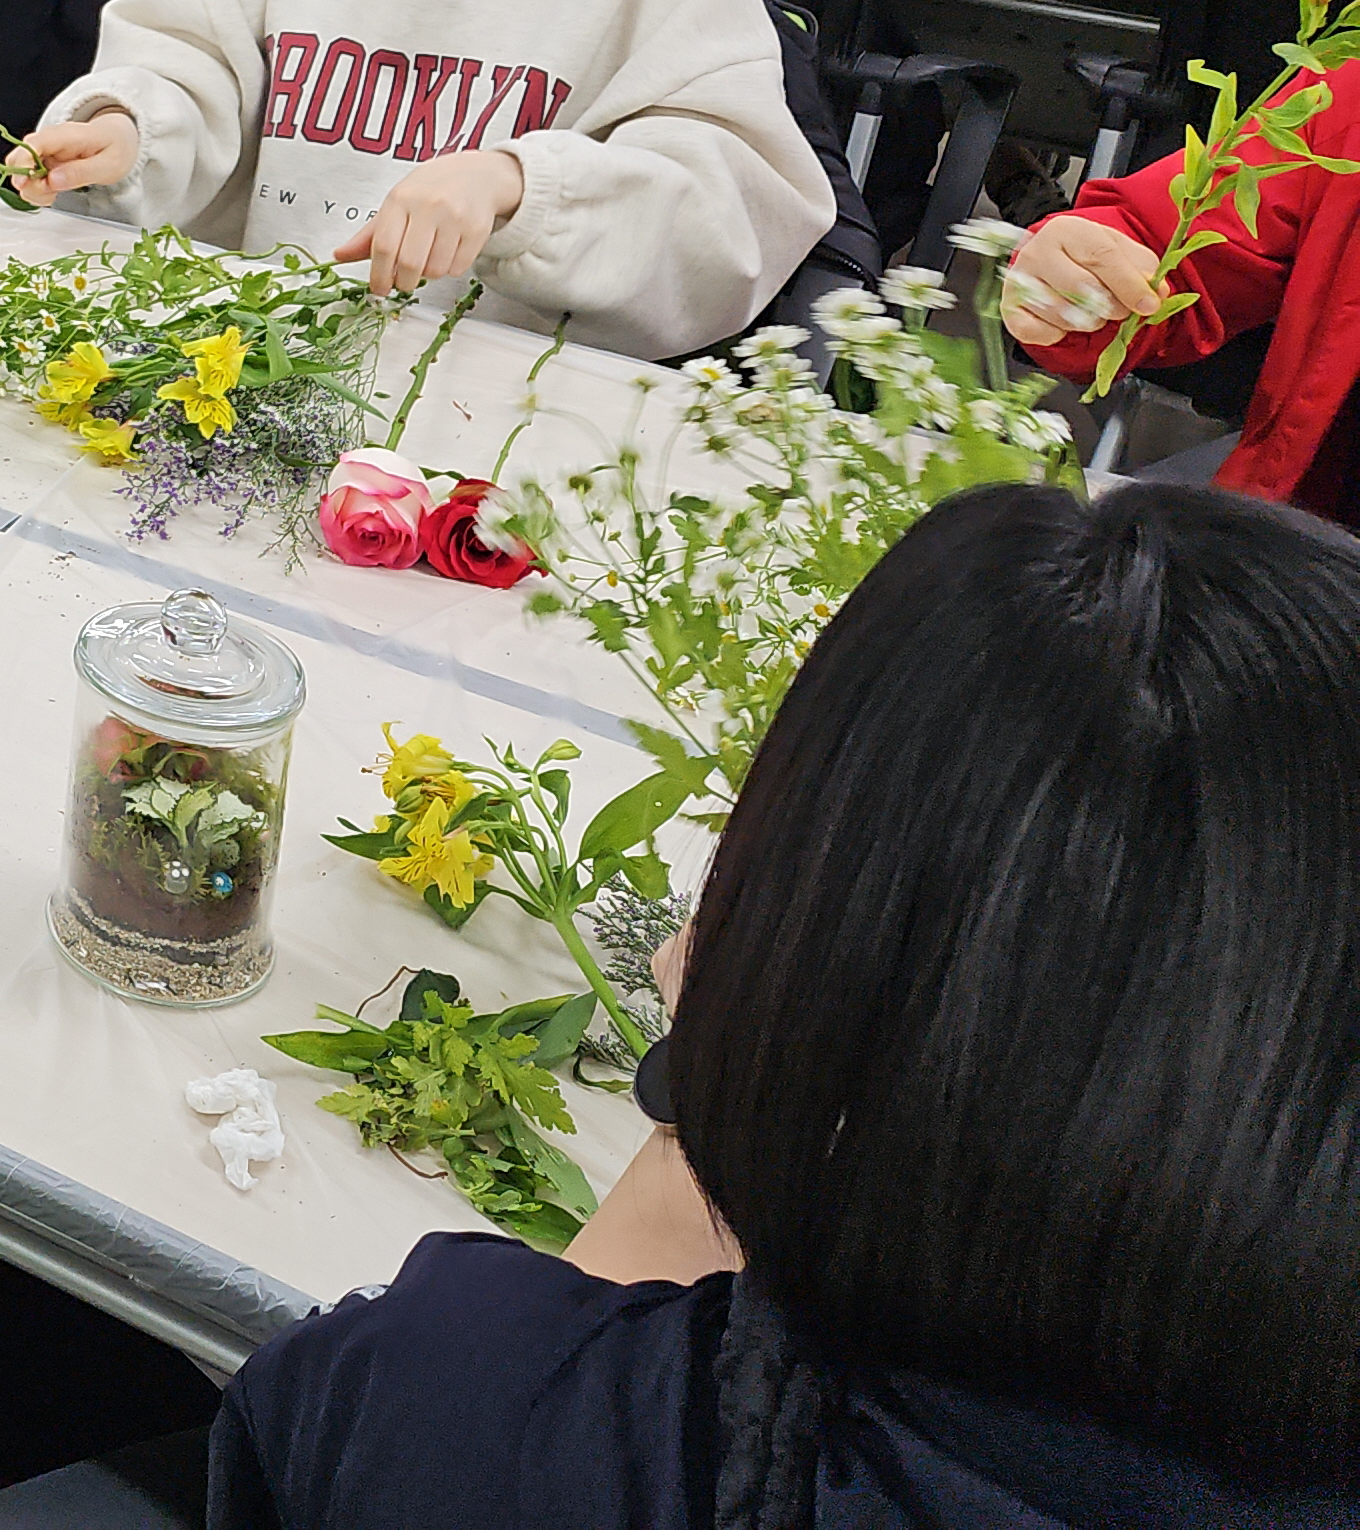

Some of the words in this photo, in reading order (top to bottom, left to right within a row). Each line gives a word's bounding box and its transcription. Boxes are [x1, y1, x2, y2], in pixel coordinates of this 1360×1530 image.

[263, 31, 573, 164] ROOKLYN
[259, 183, 298, 206] EW
[323, 200, 379, 222] YOR
